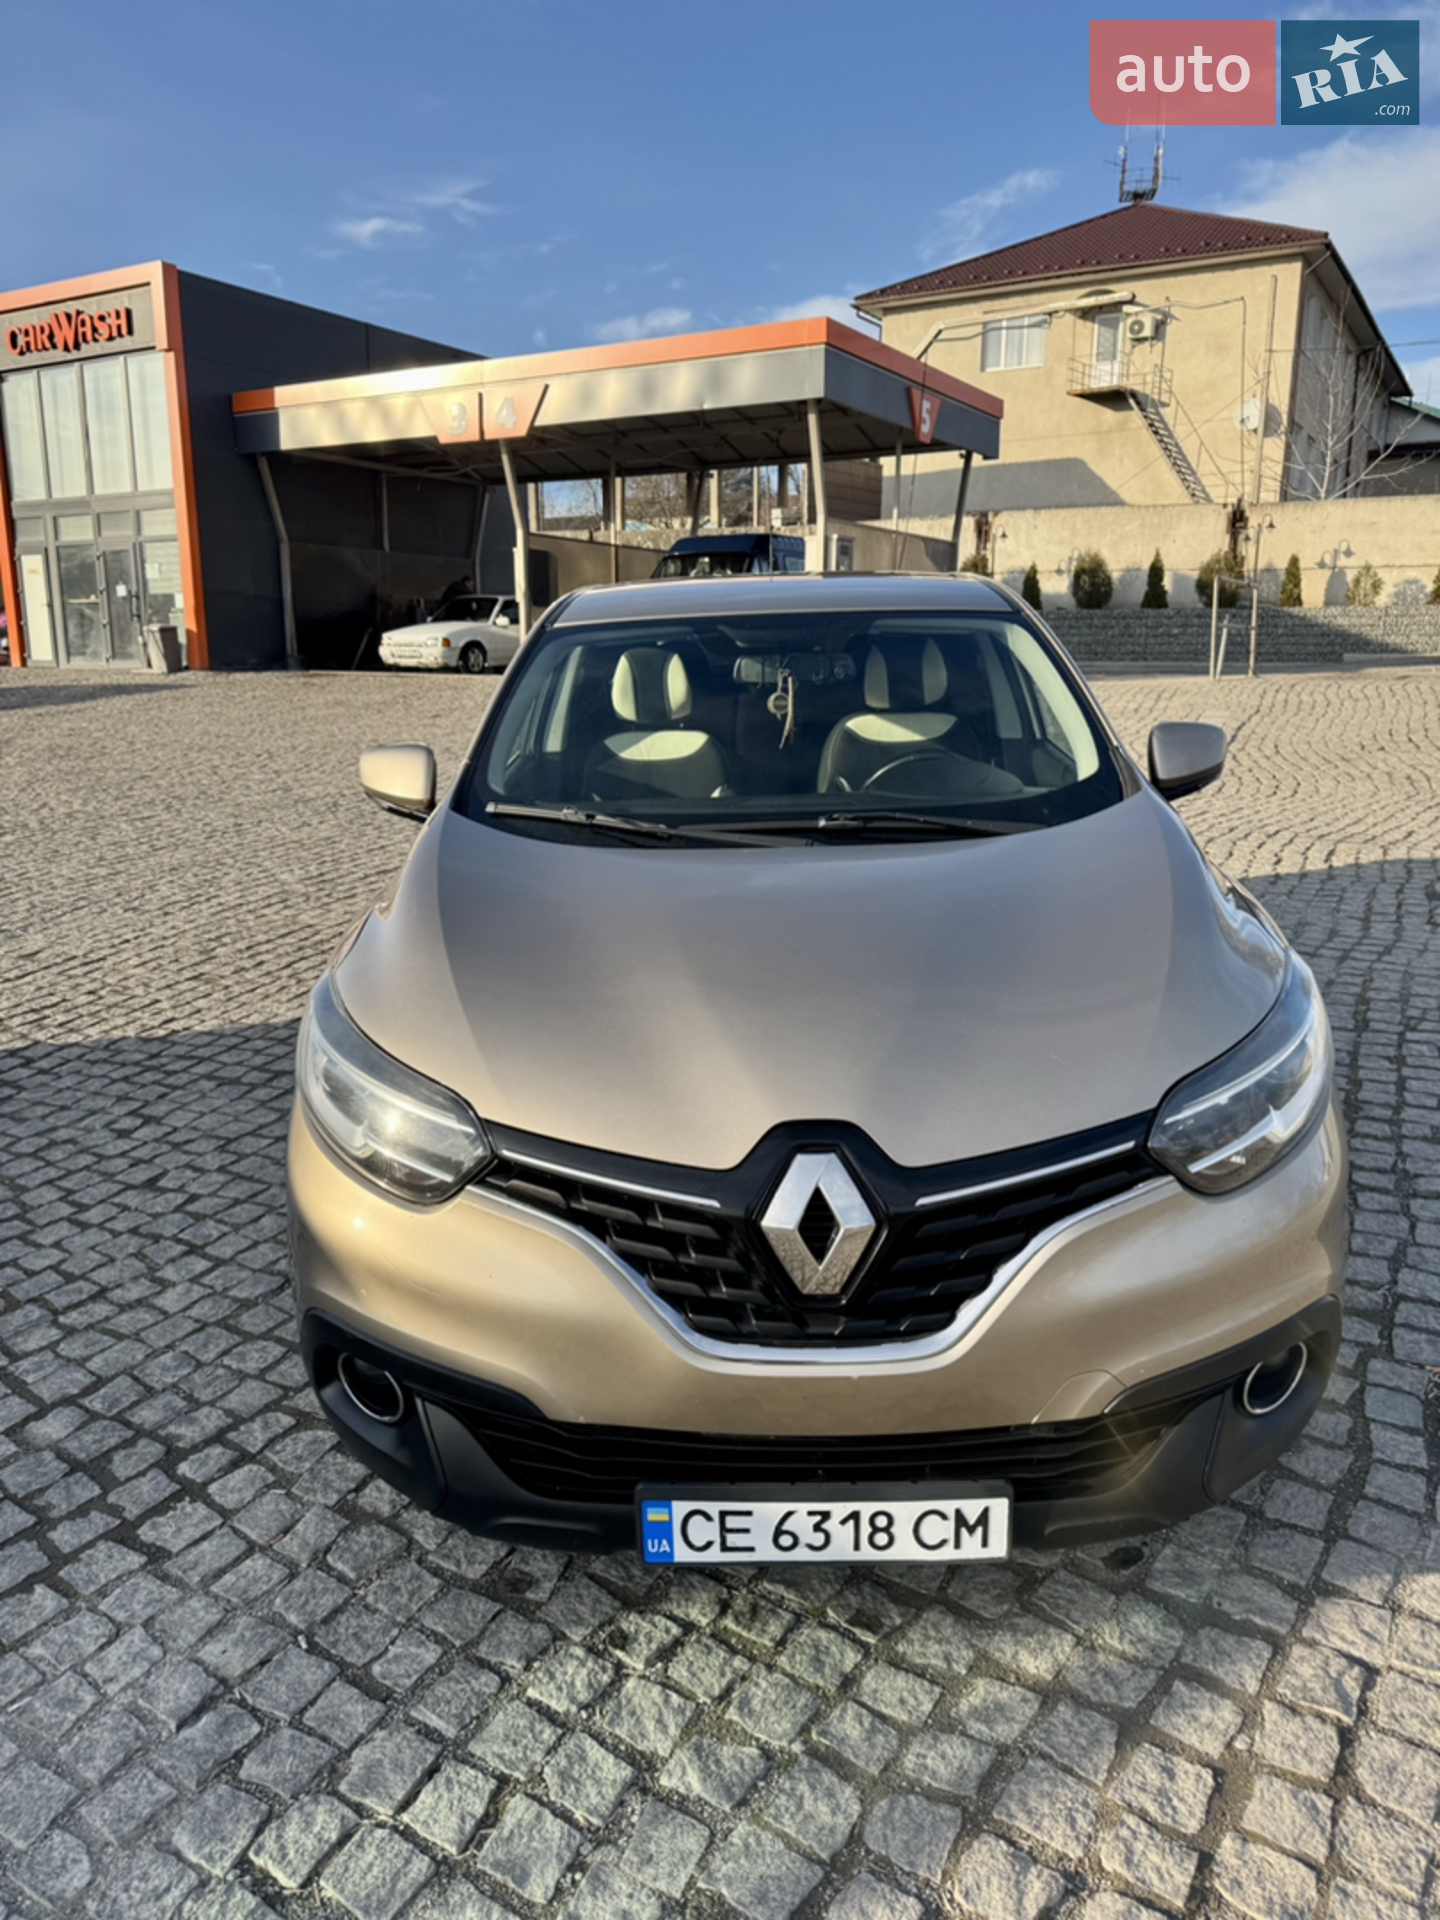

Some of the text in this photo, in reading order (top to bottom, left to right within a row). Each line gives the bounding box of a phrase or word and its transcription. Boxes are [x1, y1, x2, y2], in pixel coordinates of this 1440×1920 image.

[450, 396, 517, 436] 3 4
[921, 399, 933, 434] 5
[647, 1538, 672, 1554] UA
[679, 1506, 990, 1553] CE 6318 CM
